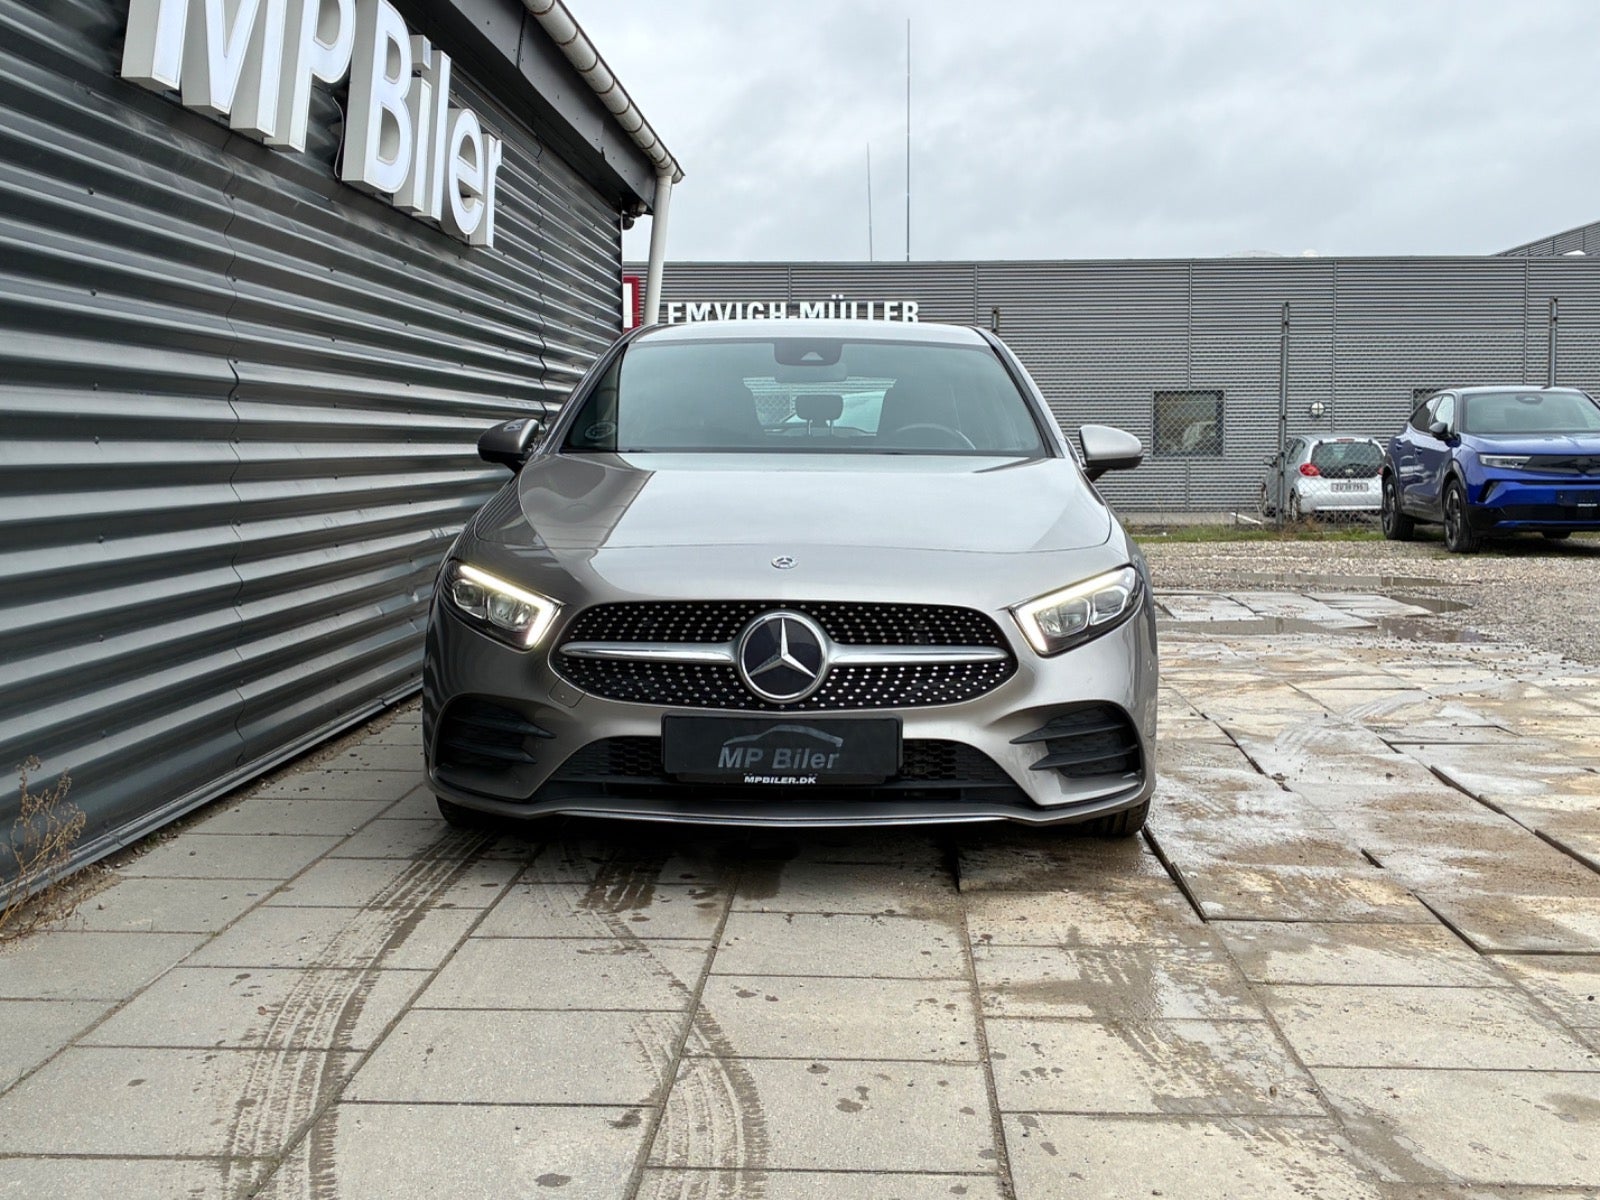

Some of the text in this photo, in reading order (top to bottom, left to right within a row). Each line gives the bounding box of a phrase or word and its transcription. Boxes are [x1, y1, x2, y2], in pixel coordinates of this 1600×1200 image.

[718, 747, 840, 769] MP Biler
[744, 775, 817, 785] MPBILER.DK
